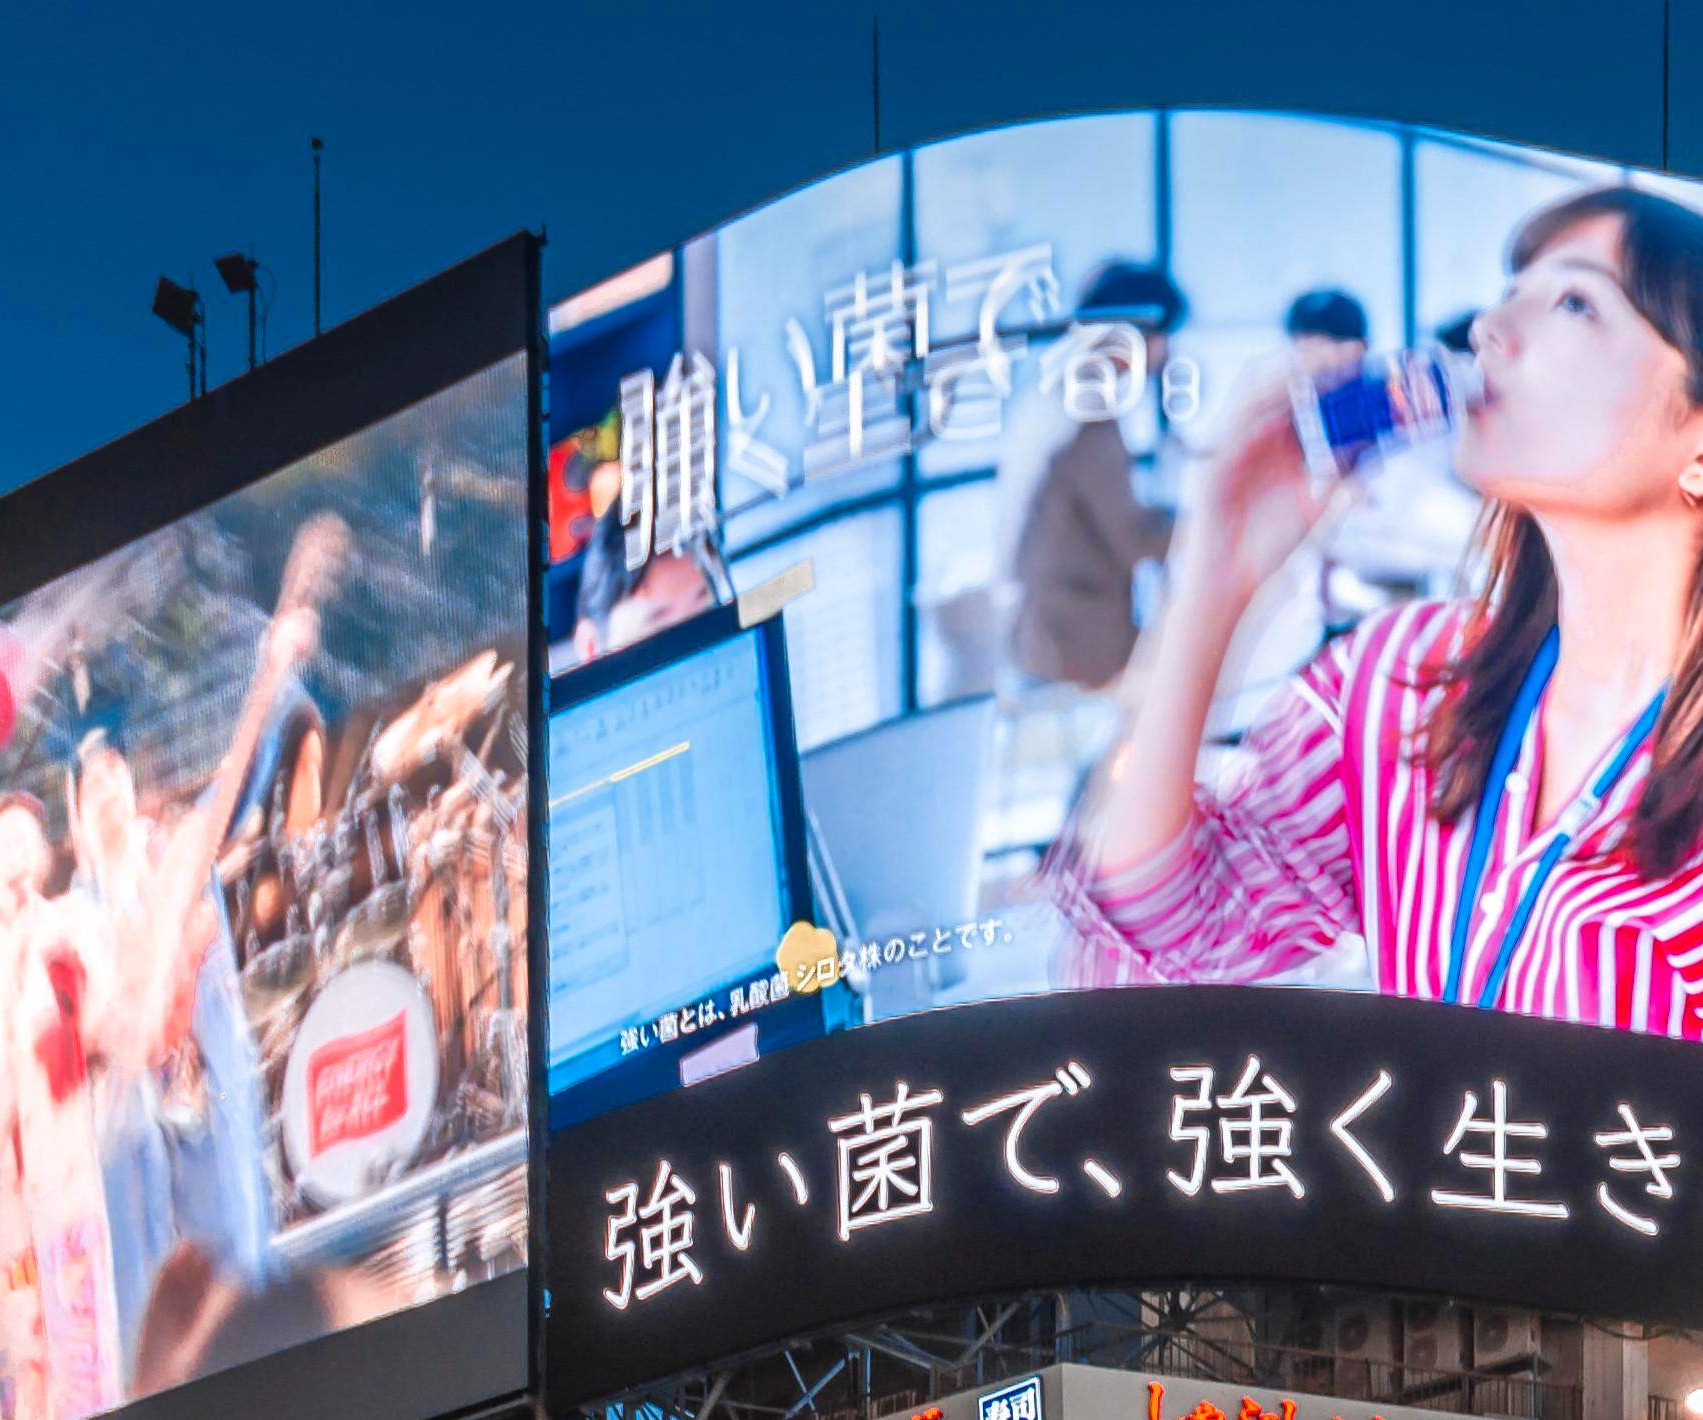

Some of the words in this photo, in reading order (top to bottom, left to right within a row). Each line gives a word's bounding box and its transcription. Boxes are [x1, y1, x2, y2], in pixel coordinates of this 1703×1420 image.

[619, 970, 790, 1057] 強い菌とは、乳酸菌
[796, 917, 1015, 991] シロタ株のことです。
